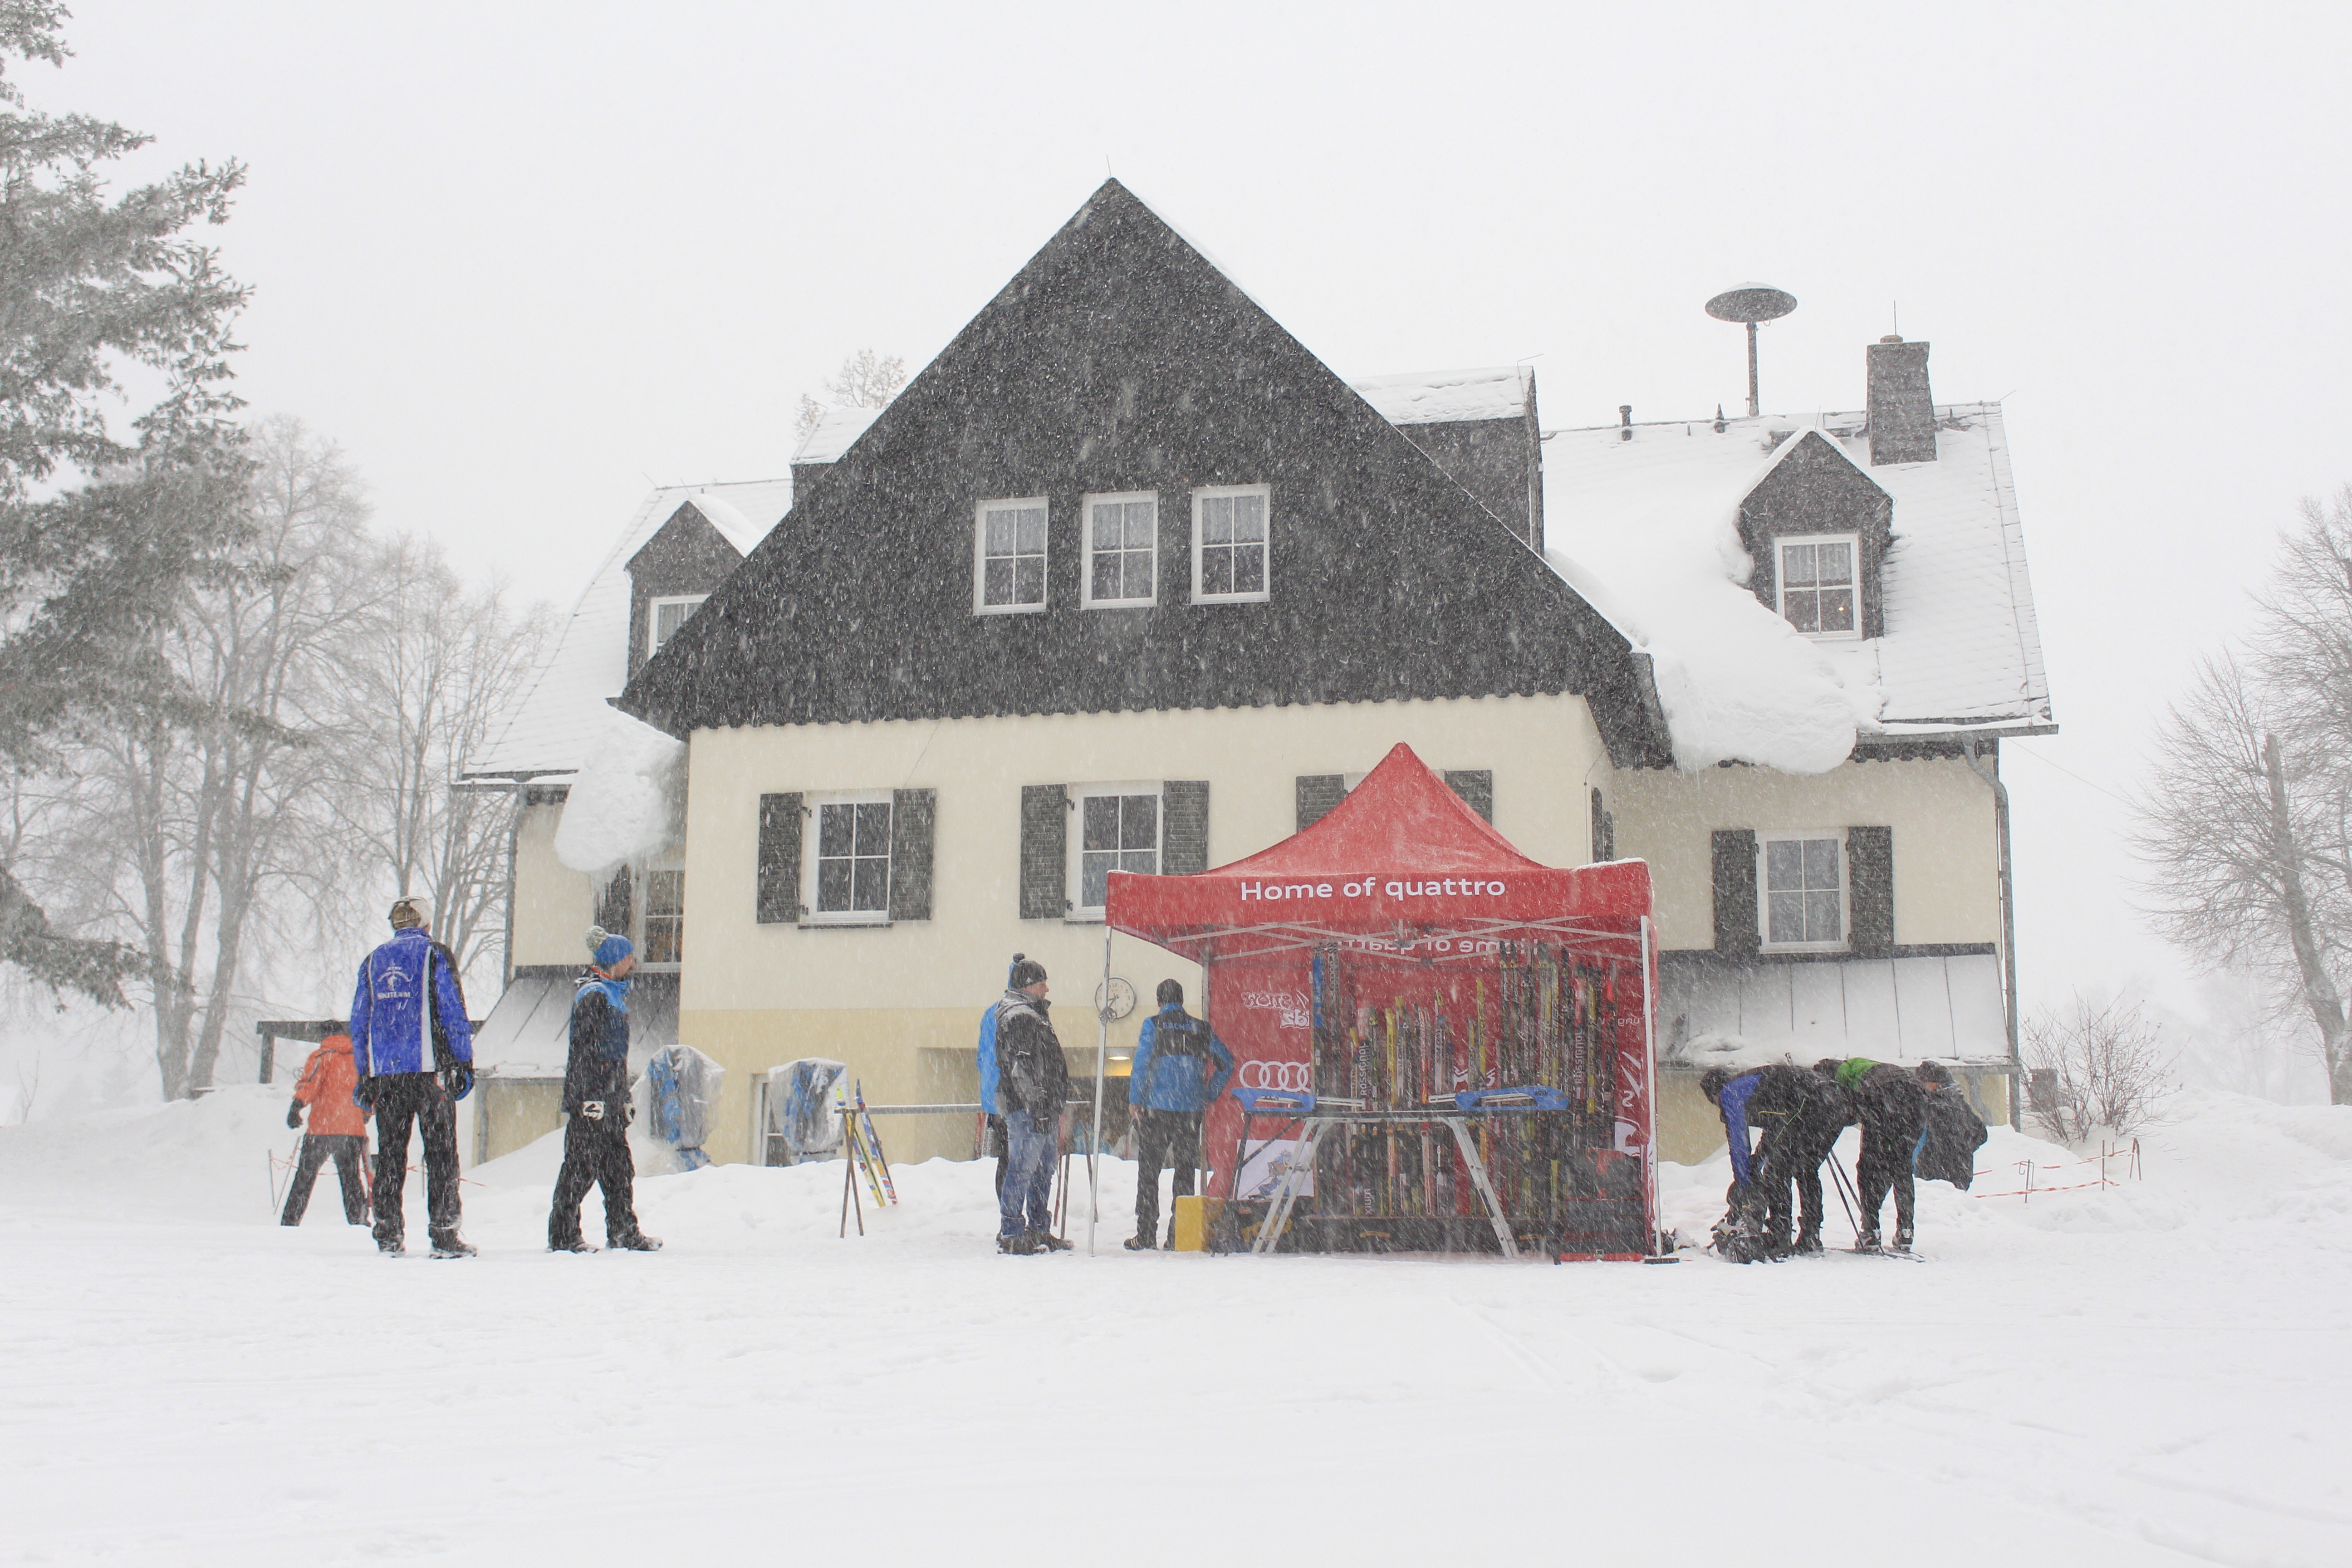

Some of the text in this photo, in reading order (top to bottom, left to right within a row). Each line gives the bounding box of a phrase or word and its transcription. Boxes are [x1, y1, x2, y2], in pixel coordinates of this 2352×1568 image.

[1240, 877, 1505, 901] Home of quattro
[1163, 1022, 1201, 1031] SACHS
[1359, 1042, 1367, 1096] ROSSIGNOL
[1575, 1028, 1583, 1084] ROSSIGNOL
